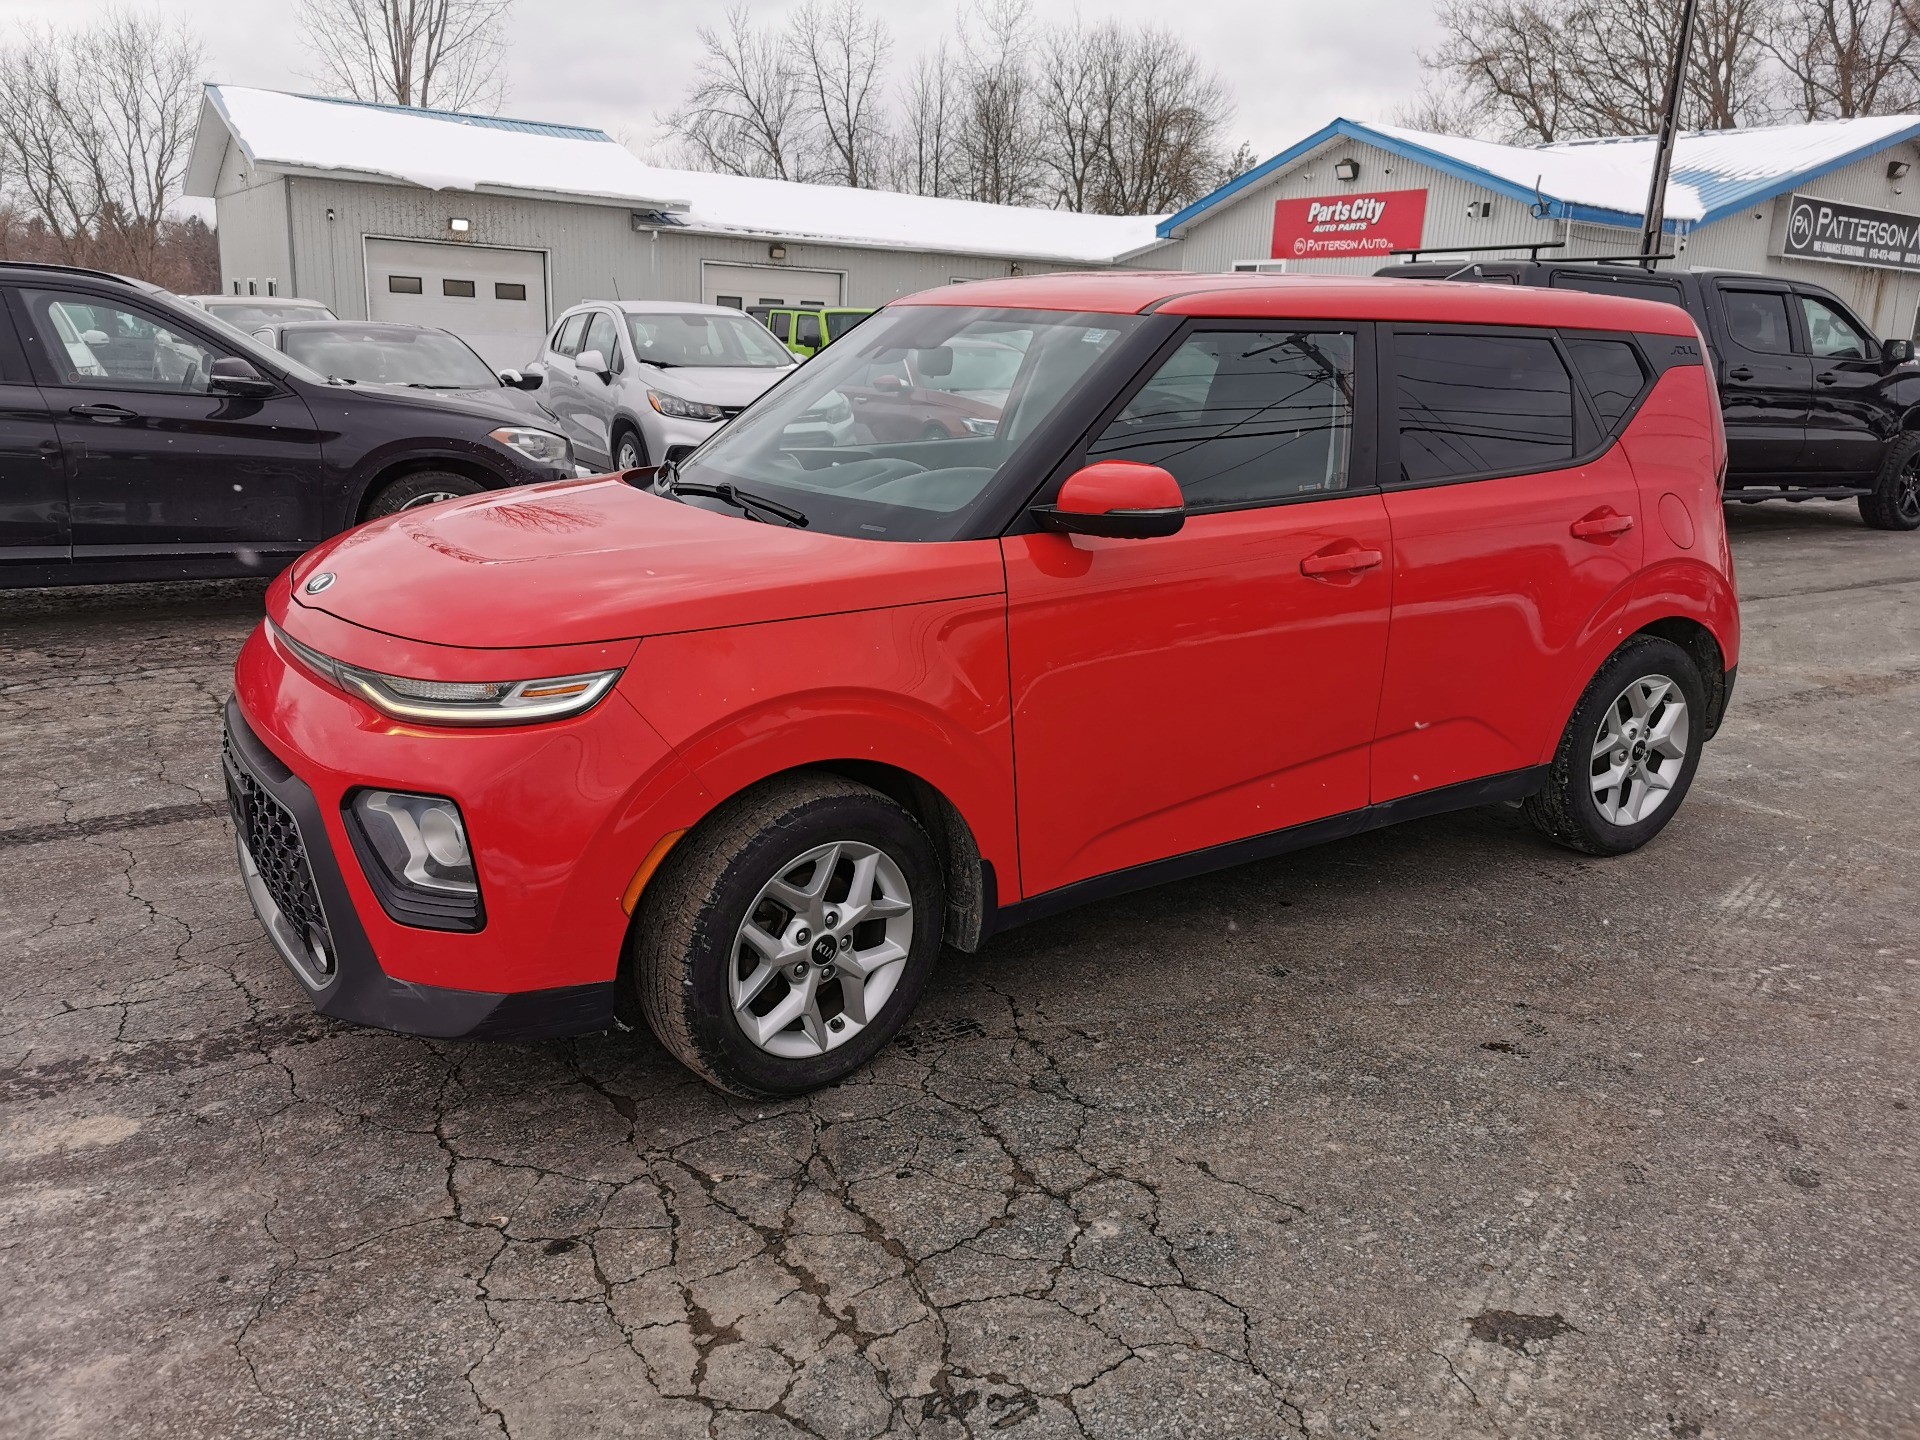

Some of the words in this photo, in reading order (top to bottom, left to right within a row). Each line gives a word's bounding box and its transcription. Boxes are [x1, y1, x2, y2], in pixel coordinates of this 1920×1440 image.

[1313, 224, 1336, 232] AUTO
[1338, 222, 1367, 231] PARTS
[1815, 207, 1909, 247] PATTERSON
[1306, 239, 1358, 251] PATTERSON
[816, 941, 834, 959] KIA
